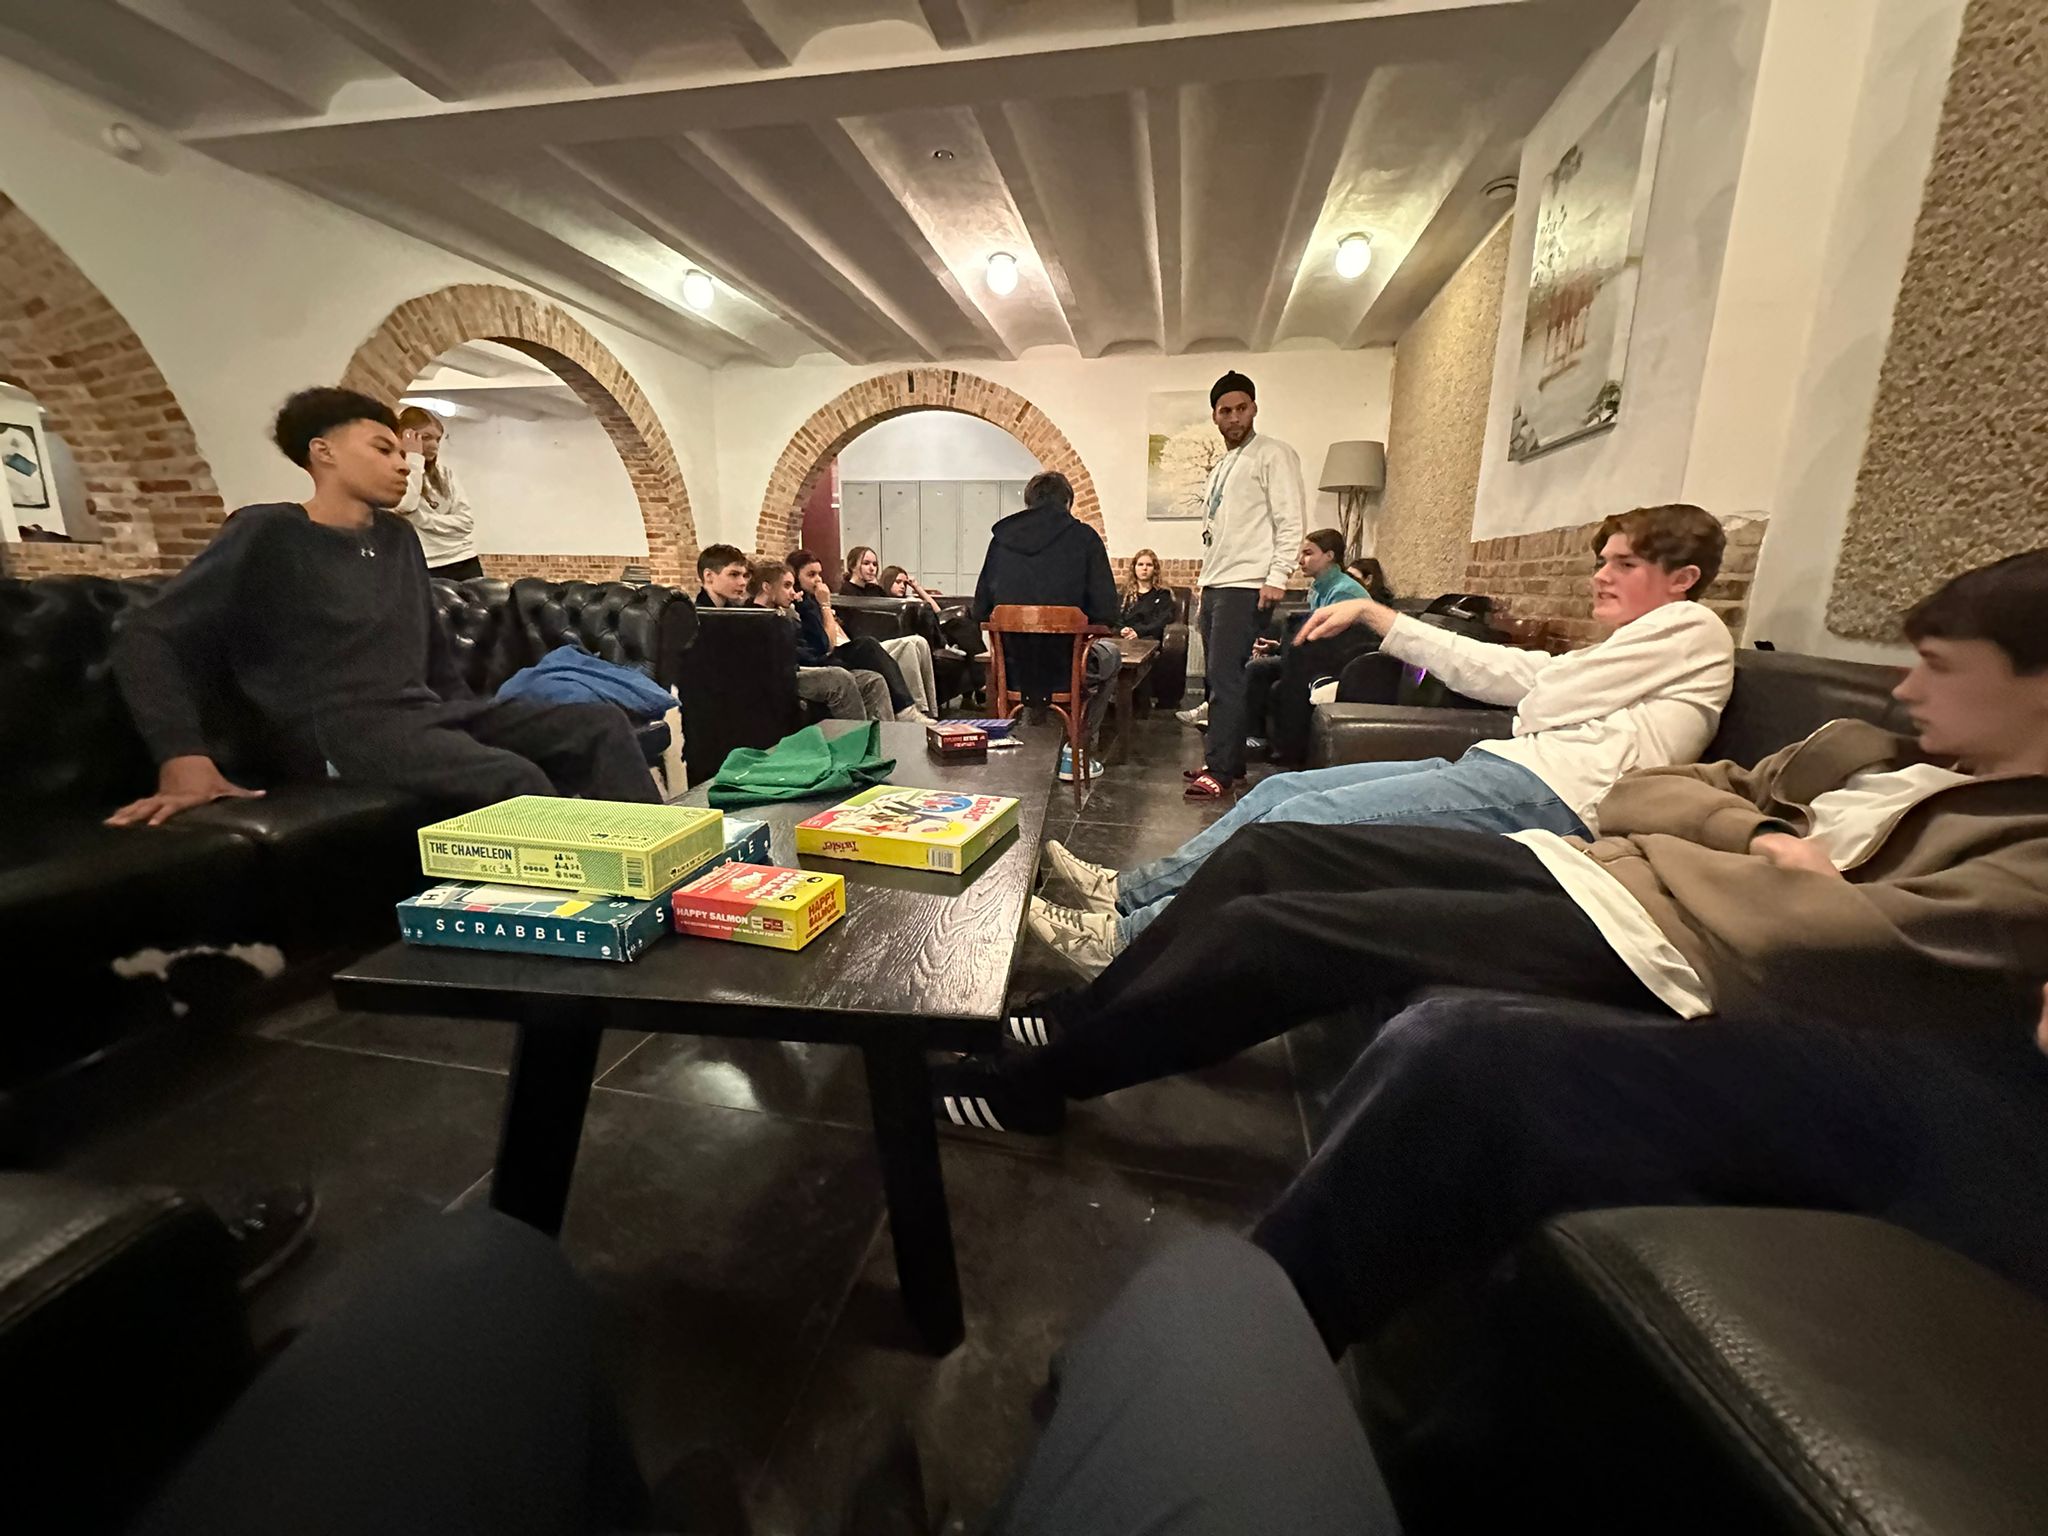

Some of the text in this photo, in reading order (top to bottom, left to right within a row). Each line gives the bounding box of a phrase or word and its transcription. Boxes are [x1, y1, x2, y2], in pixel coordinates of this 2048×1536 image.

[430, 842, 512, 860] THE CHAMELEON
[822, 841, 860, 853] Twister
[809, 888, 836, 918] HAPPY
[676, 907, 707, 919] HAPPY
[709, 912, 749, 924] SALMON
[809, 901, 837, 928] SALMON
[436, 918, 586, 943] SCRABBLE
